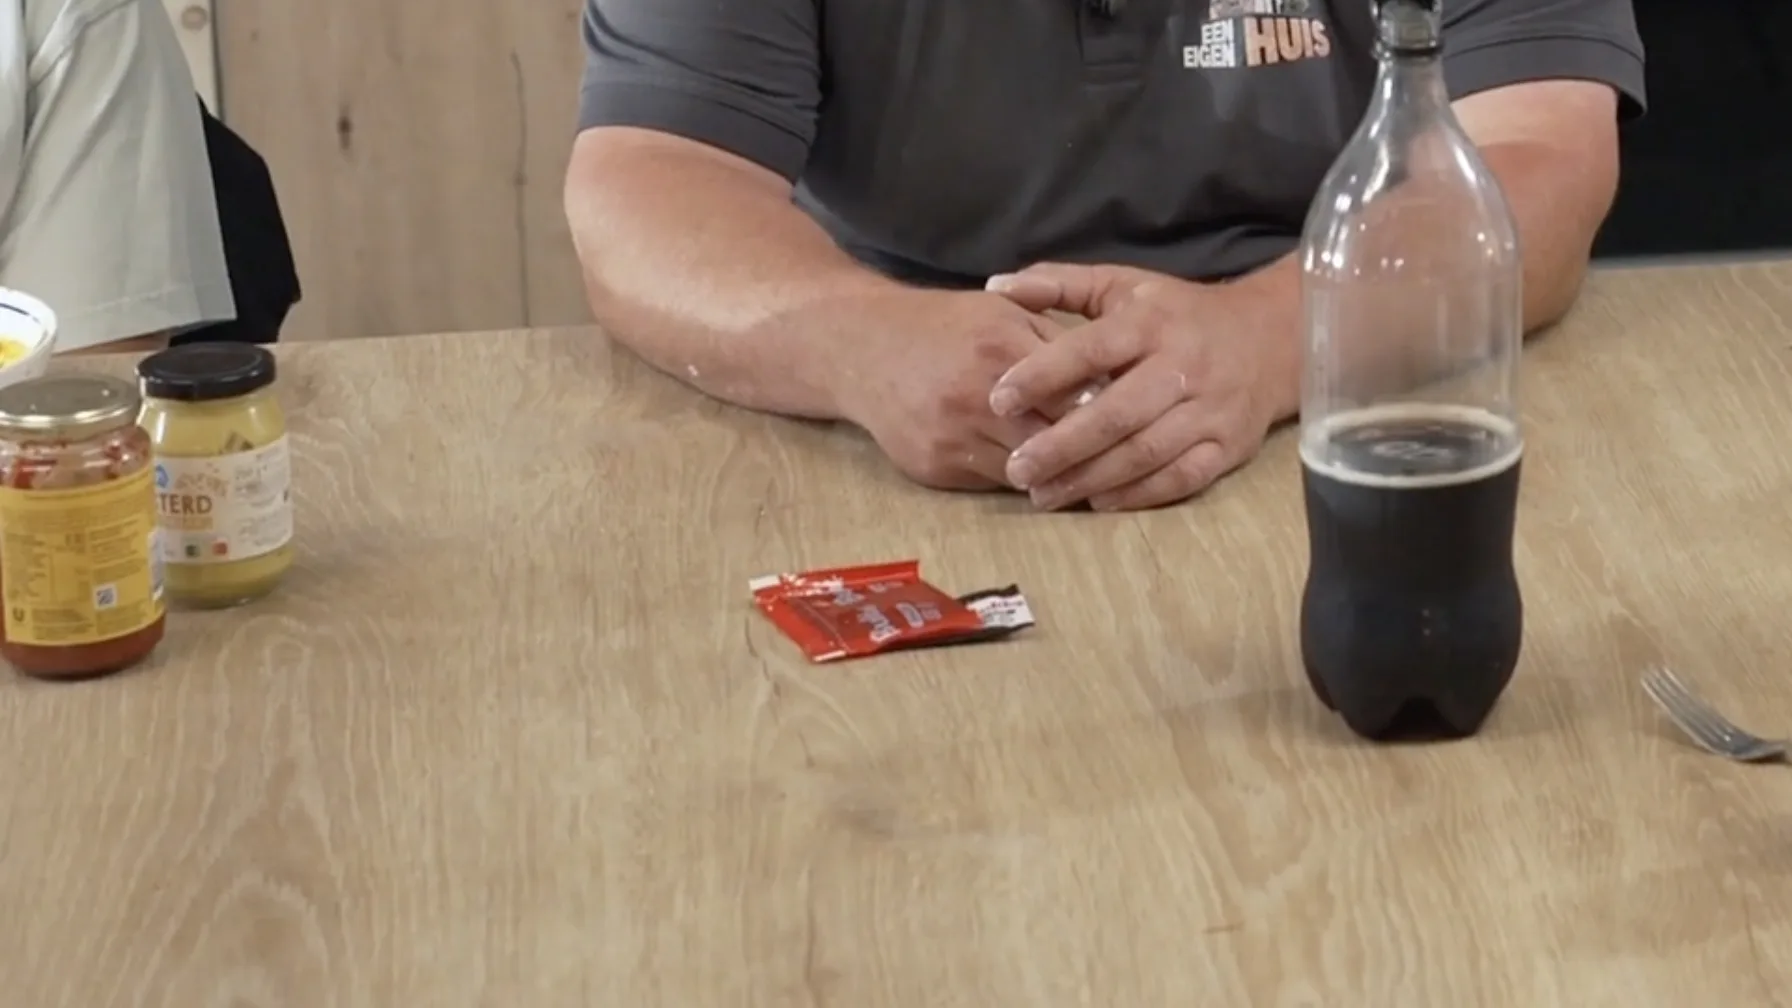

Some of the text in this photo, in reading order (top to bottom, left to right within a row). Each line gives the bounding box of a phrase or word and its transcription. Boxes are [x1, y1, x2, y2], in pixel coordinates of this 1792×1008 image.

[1202, 18, 1235, 45] EEN
[1245, 17, 1330, 67] HUIS
[1184, 45, 1236, 68] EIGEN
[158, 492, 213, 515] TERD
